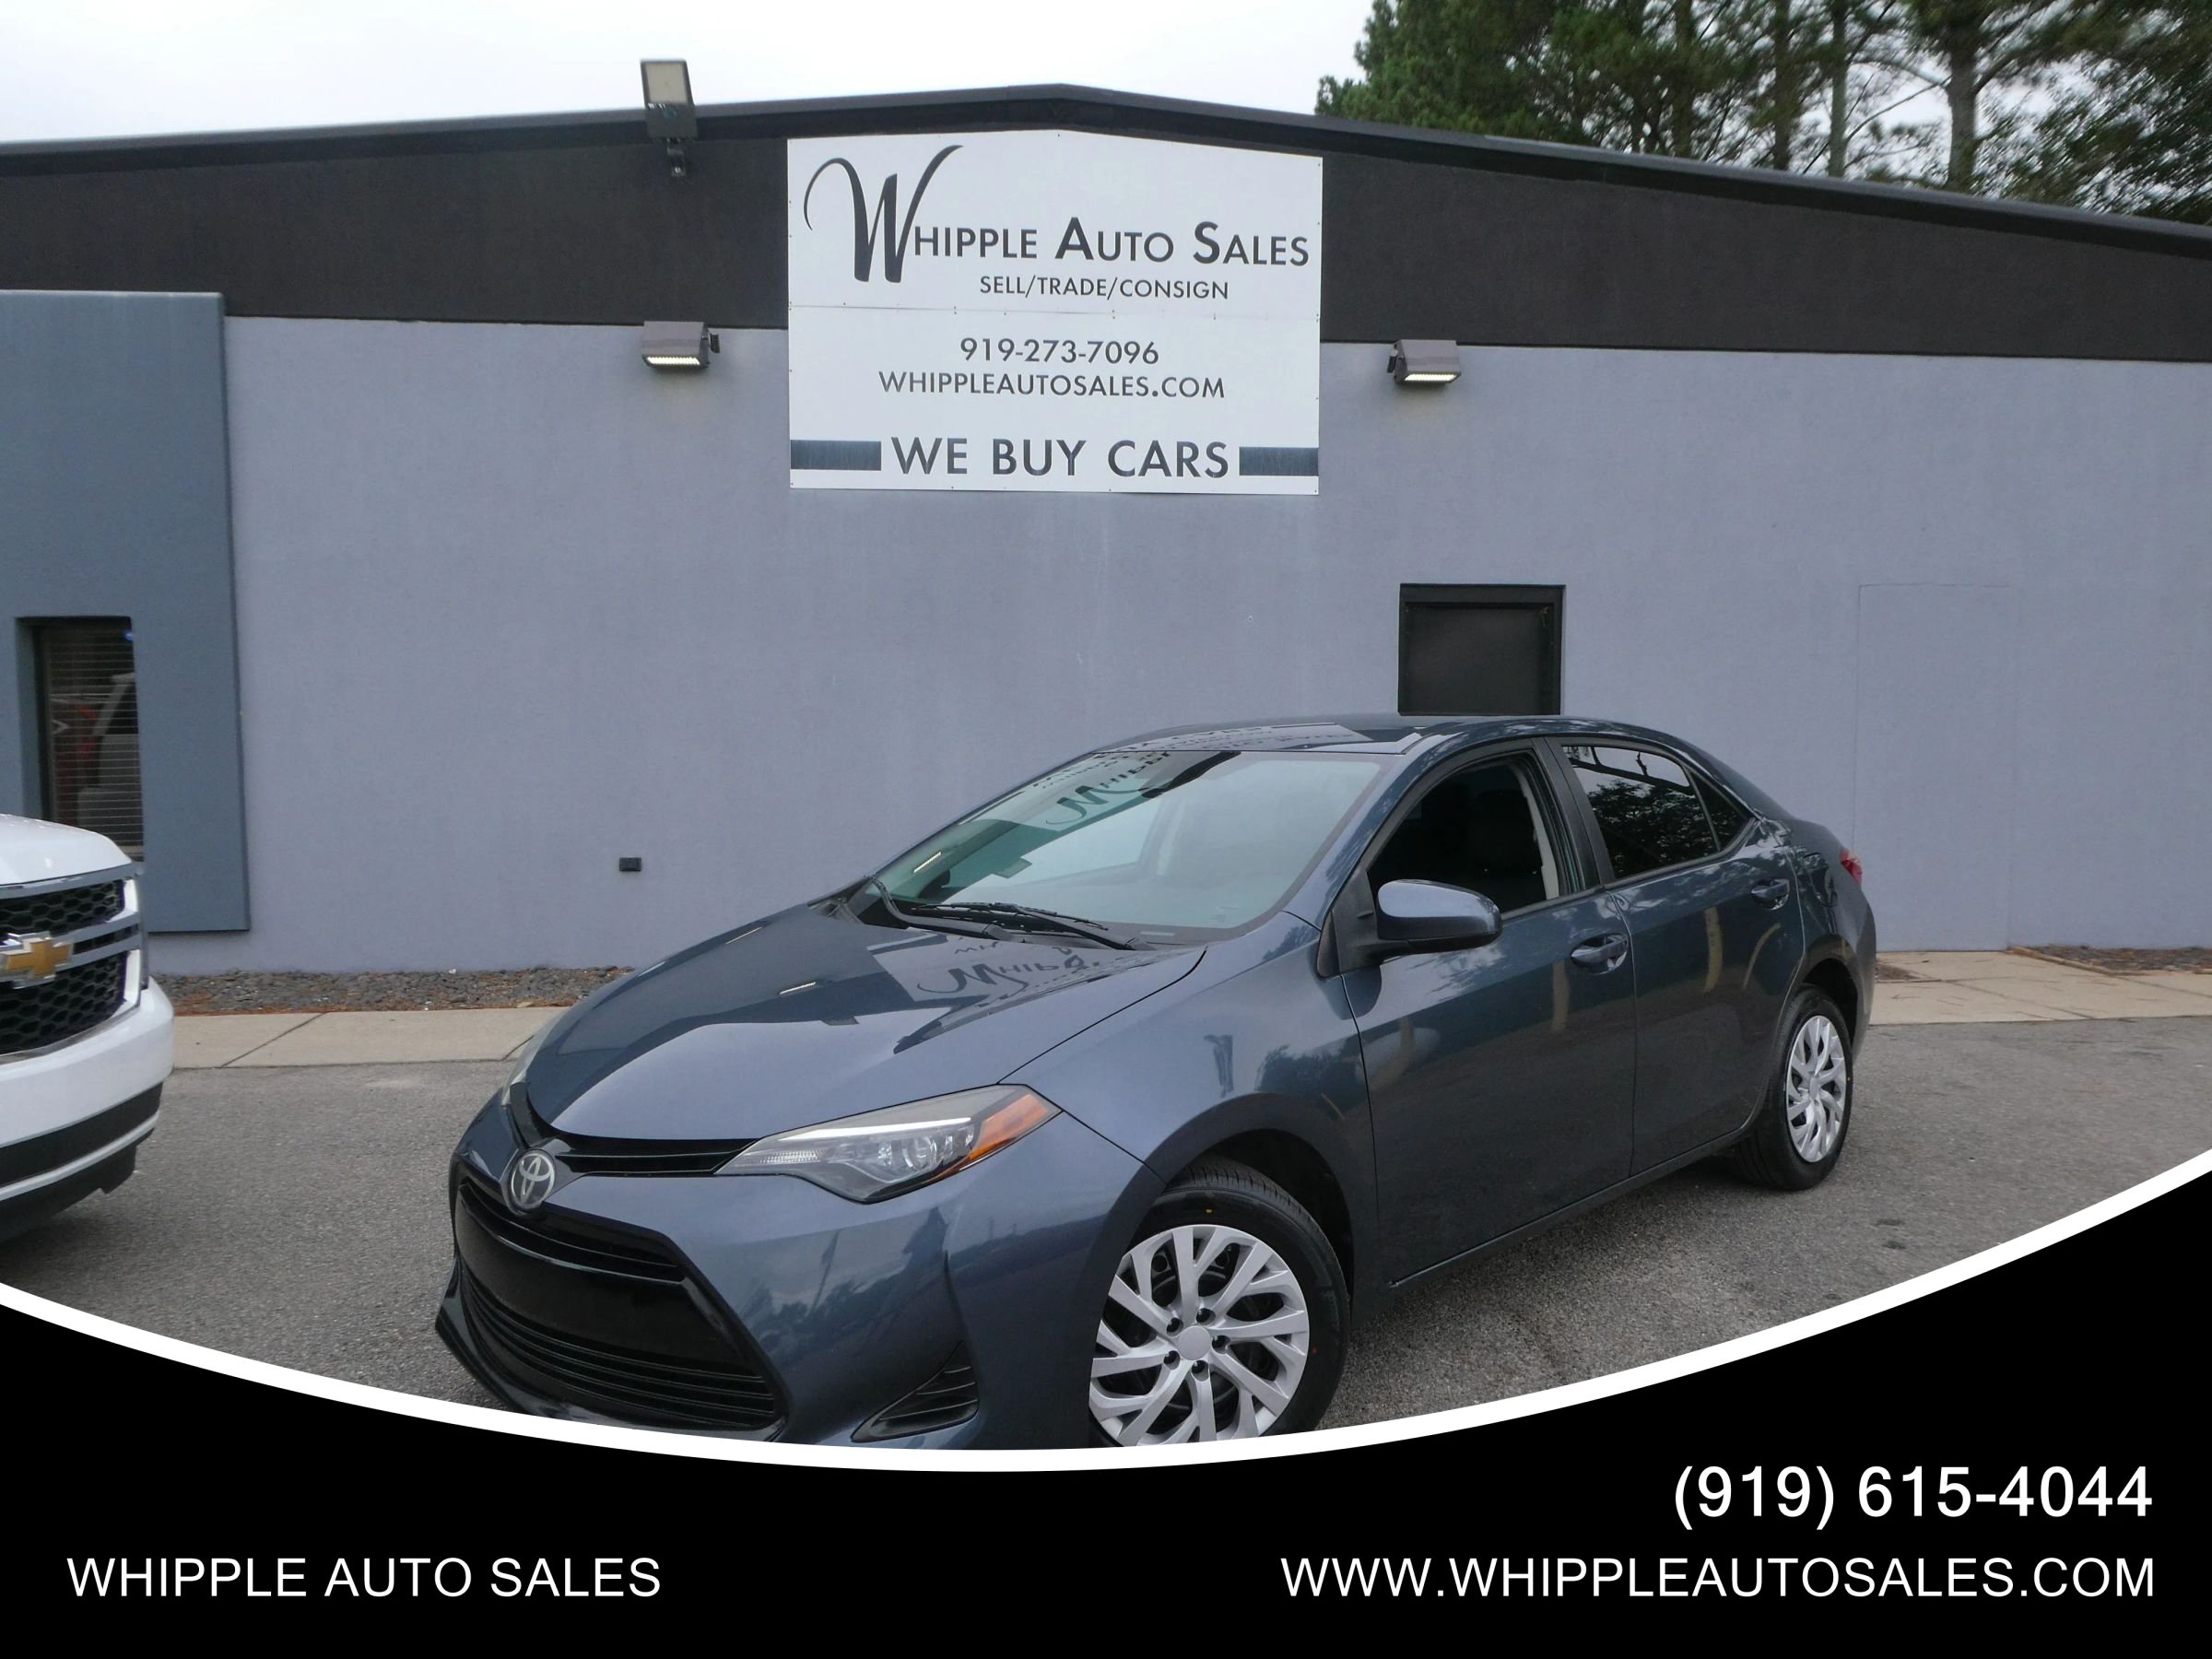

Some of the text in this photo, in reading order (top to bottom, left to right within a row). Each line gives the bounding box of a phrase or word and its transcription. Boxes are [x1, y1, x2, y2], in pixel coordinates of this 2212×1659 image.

[803, 145, 1309, 284] WHIPPLE AUTO SALES
[980, 275, 1229, 300] SELL/TRADE/CONSIGN
[960, 337, 1159, 365] 919-273-7096
[878, 371, 1225, 398] WHIPPLEAUTOSALES.COM
[890, 437, 1229, 478] WE BUY CARS
